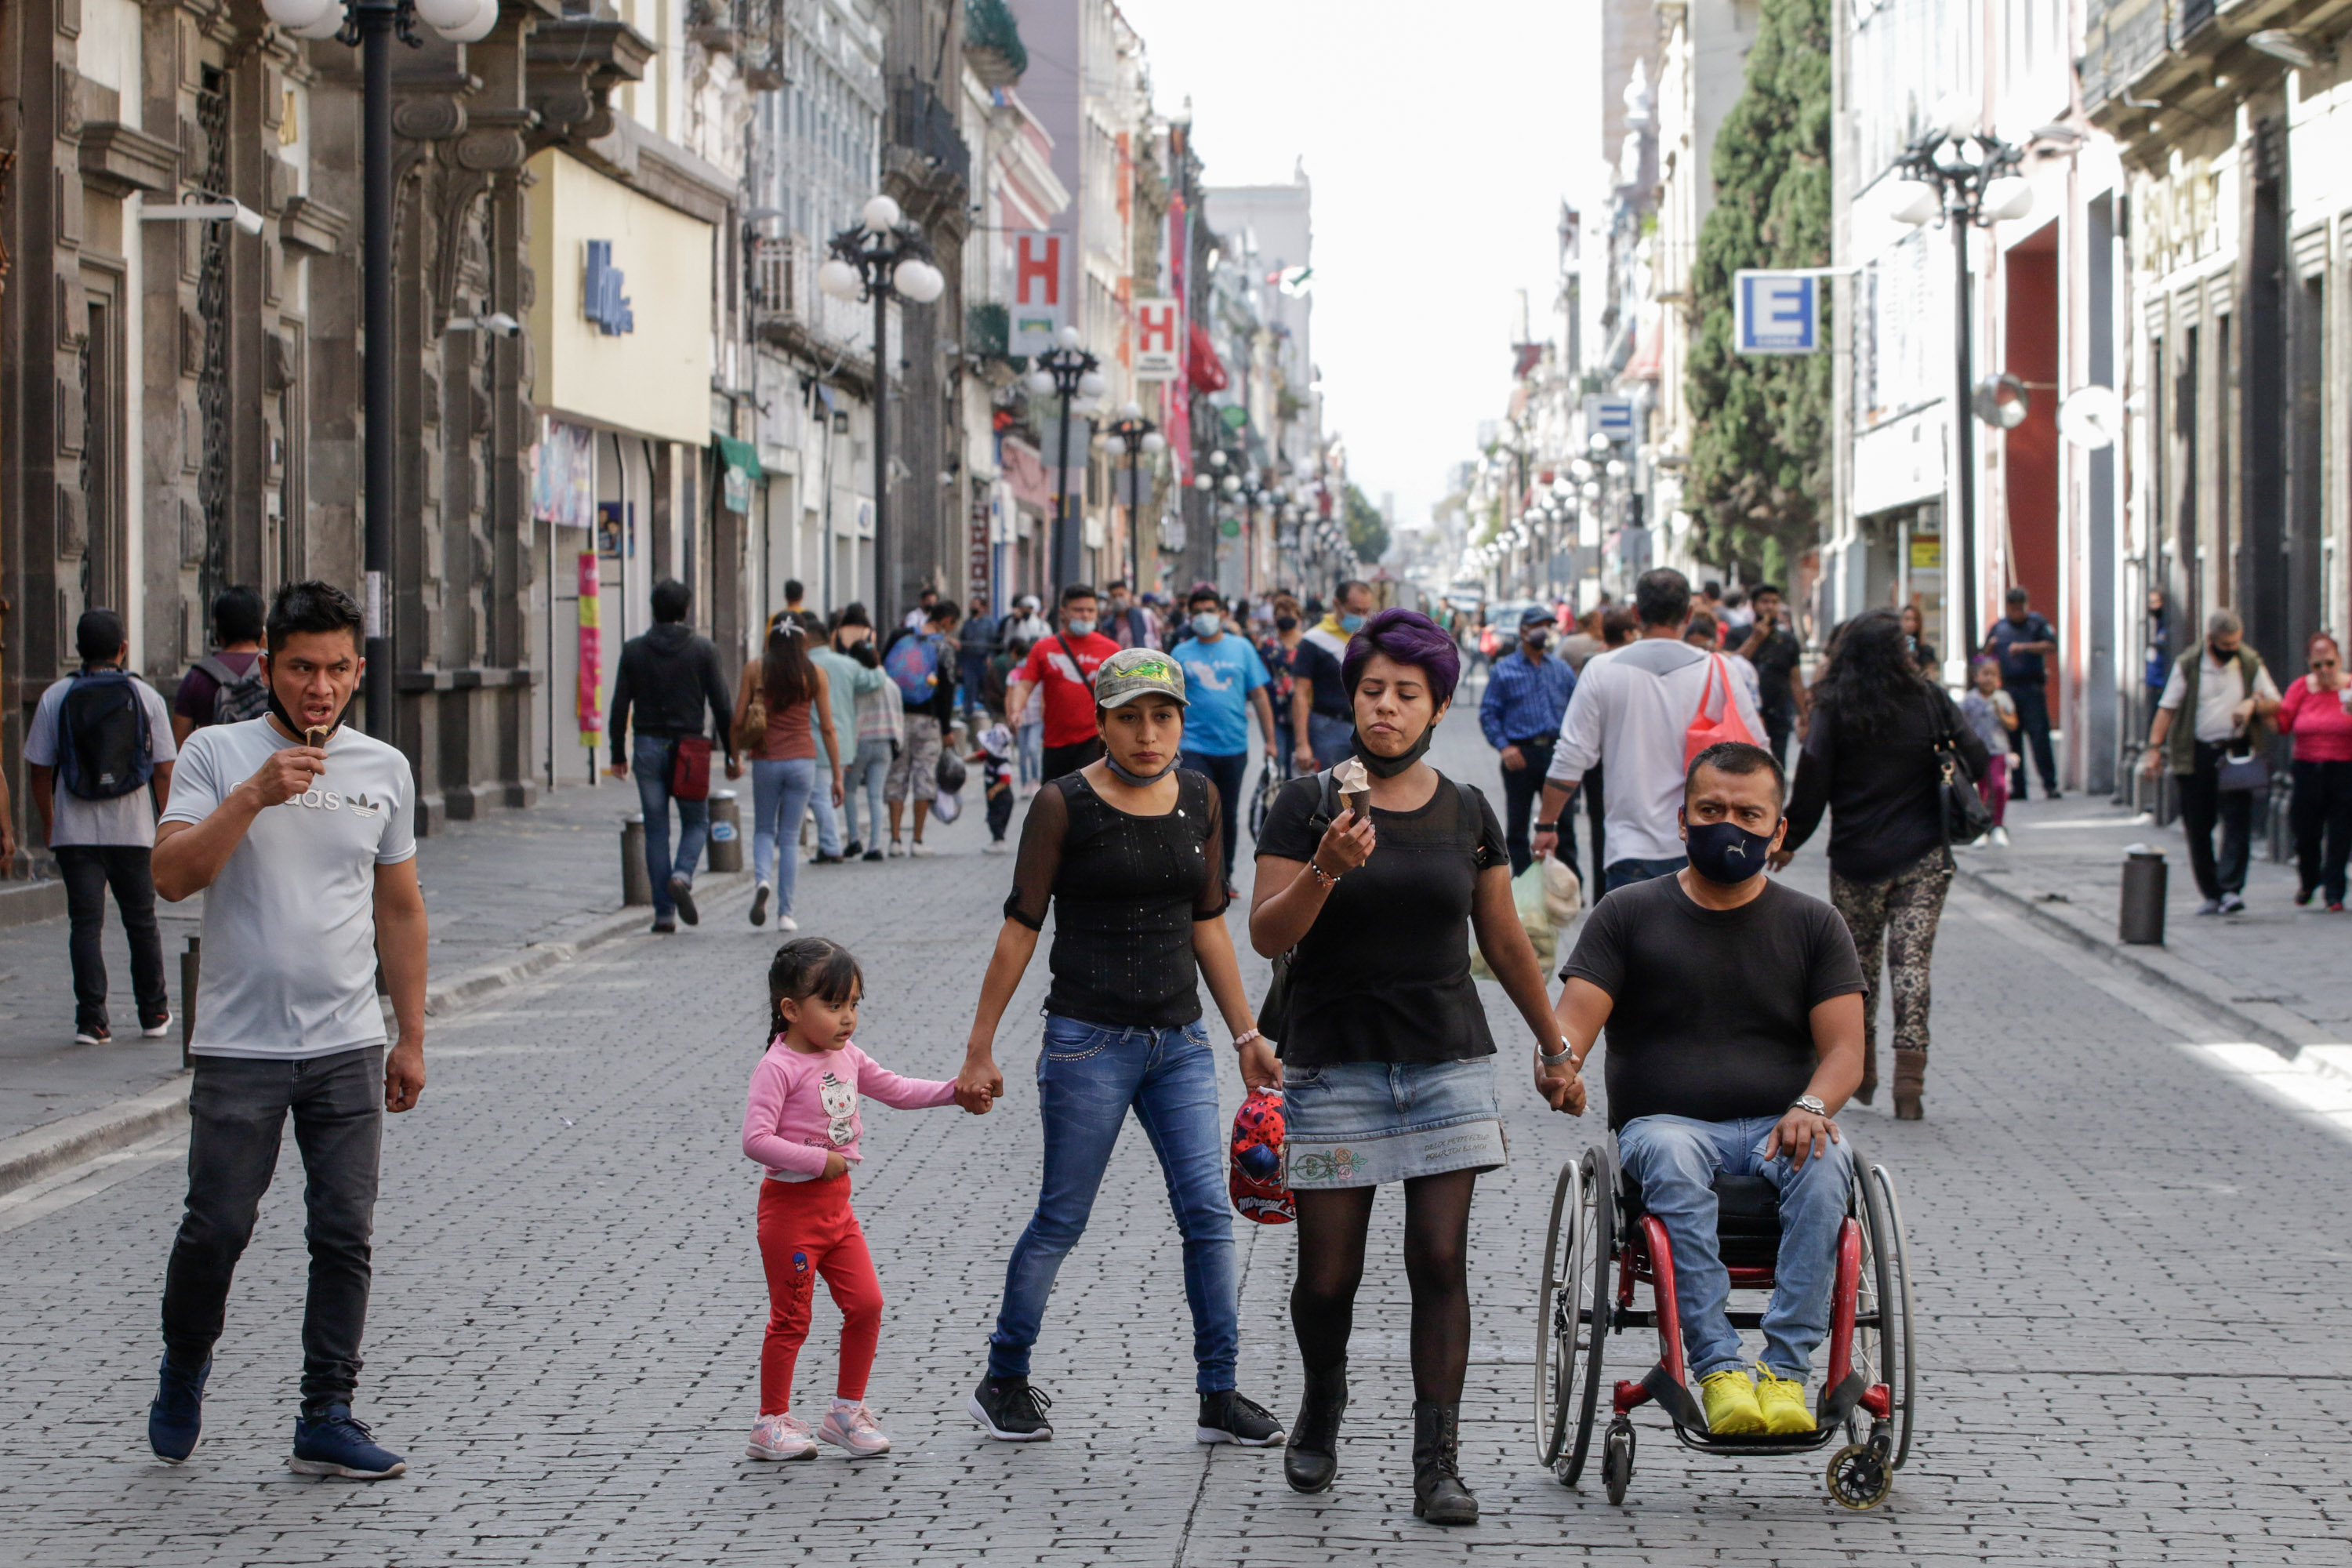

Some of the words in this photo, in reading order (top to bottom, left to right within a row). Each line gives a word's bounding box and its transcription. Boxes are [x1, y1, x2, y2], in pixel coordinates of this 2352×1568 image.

[1017, 236, 1060, 305] H
[1140, 306, 1173, 351] H
[1753, 278, 1803, 336] E
[1425, 1150, 1449, 1160] POUR
